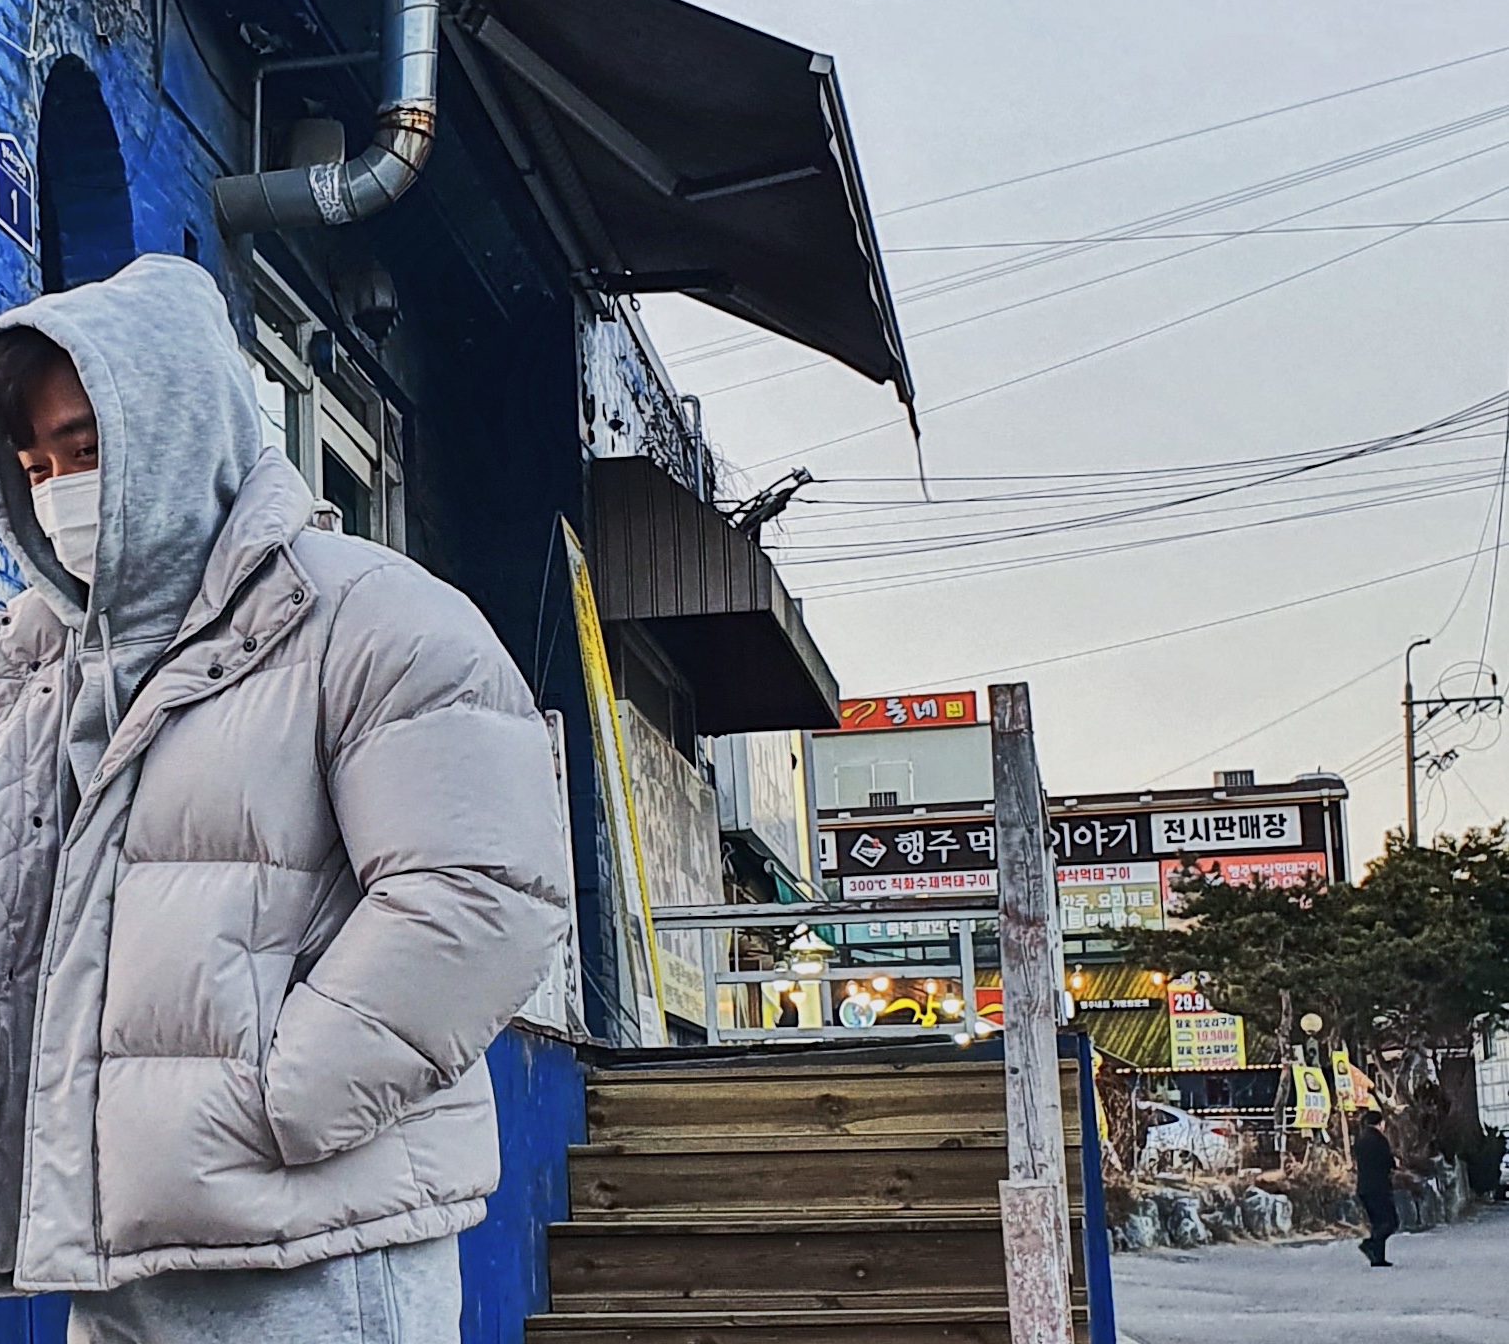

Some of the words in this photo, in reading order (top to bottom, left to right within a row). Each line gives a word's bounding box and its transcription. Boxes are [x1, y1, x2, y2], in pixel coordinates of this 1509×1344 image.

[883, 697, 939, 725] 동네
[1162, 812, 1288, 844] 전시판매장
[893, 829, 961, 866] 행주
